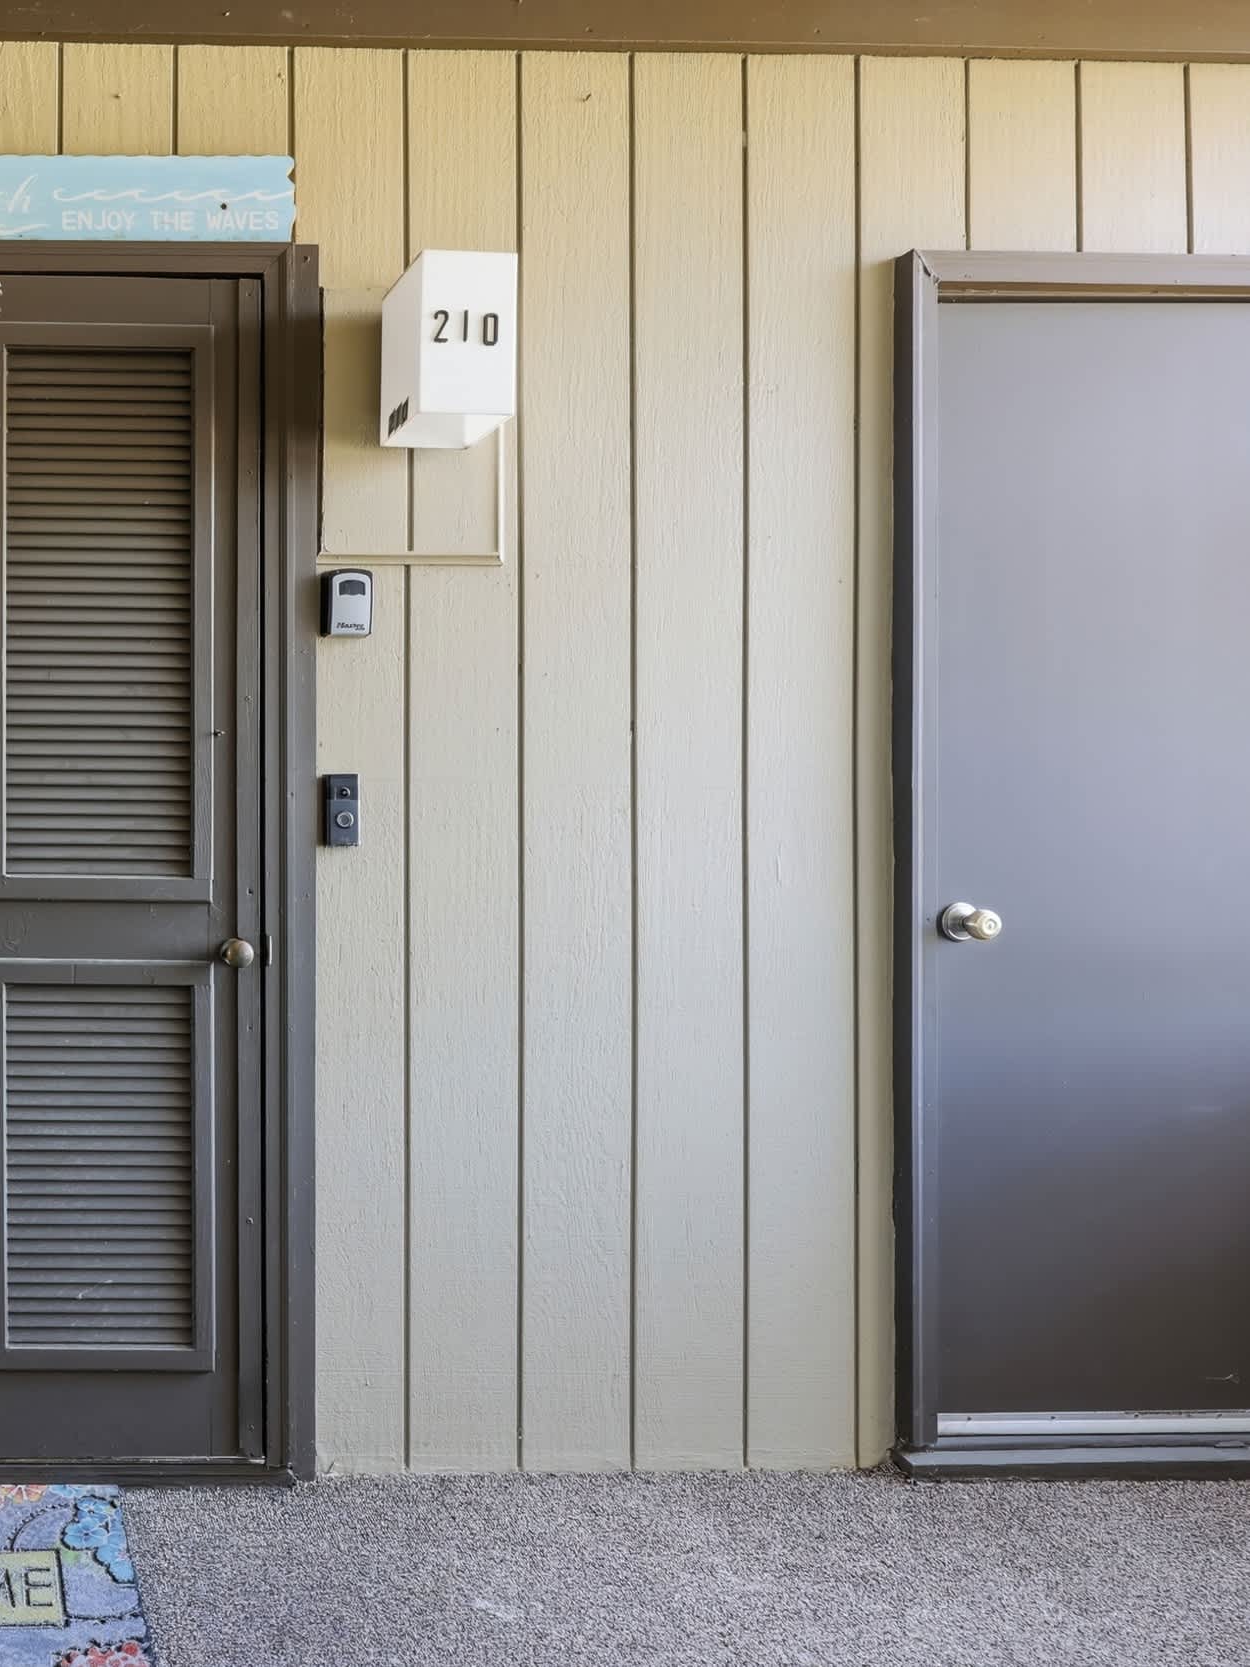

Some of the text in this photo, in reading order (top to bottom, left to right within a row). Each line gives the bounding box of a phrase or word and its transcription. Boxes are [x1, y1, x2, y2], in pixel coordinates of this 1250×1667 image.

[61, 211, 279, 232] ENJOY THE WAVES
[433, 309, 499, 346] 210
